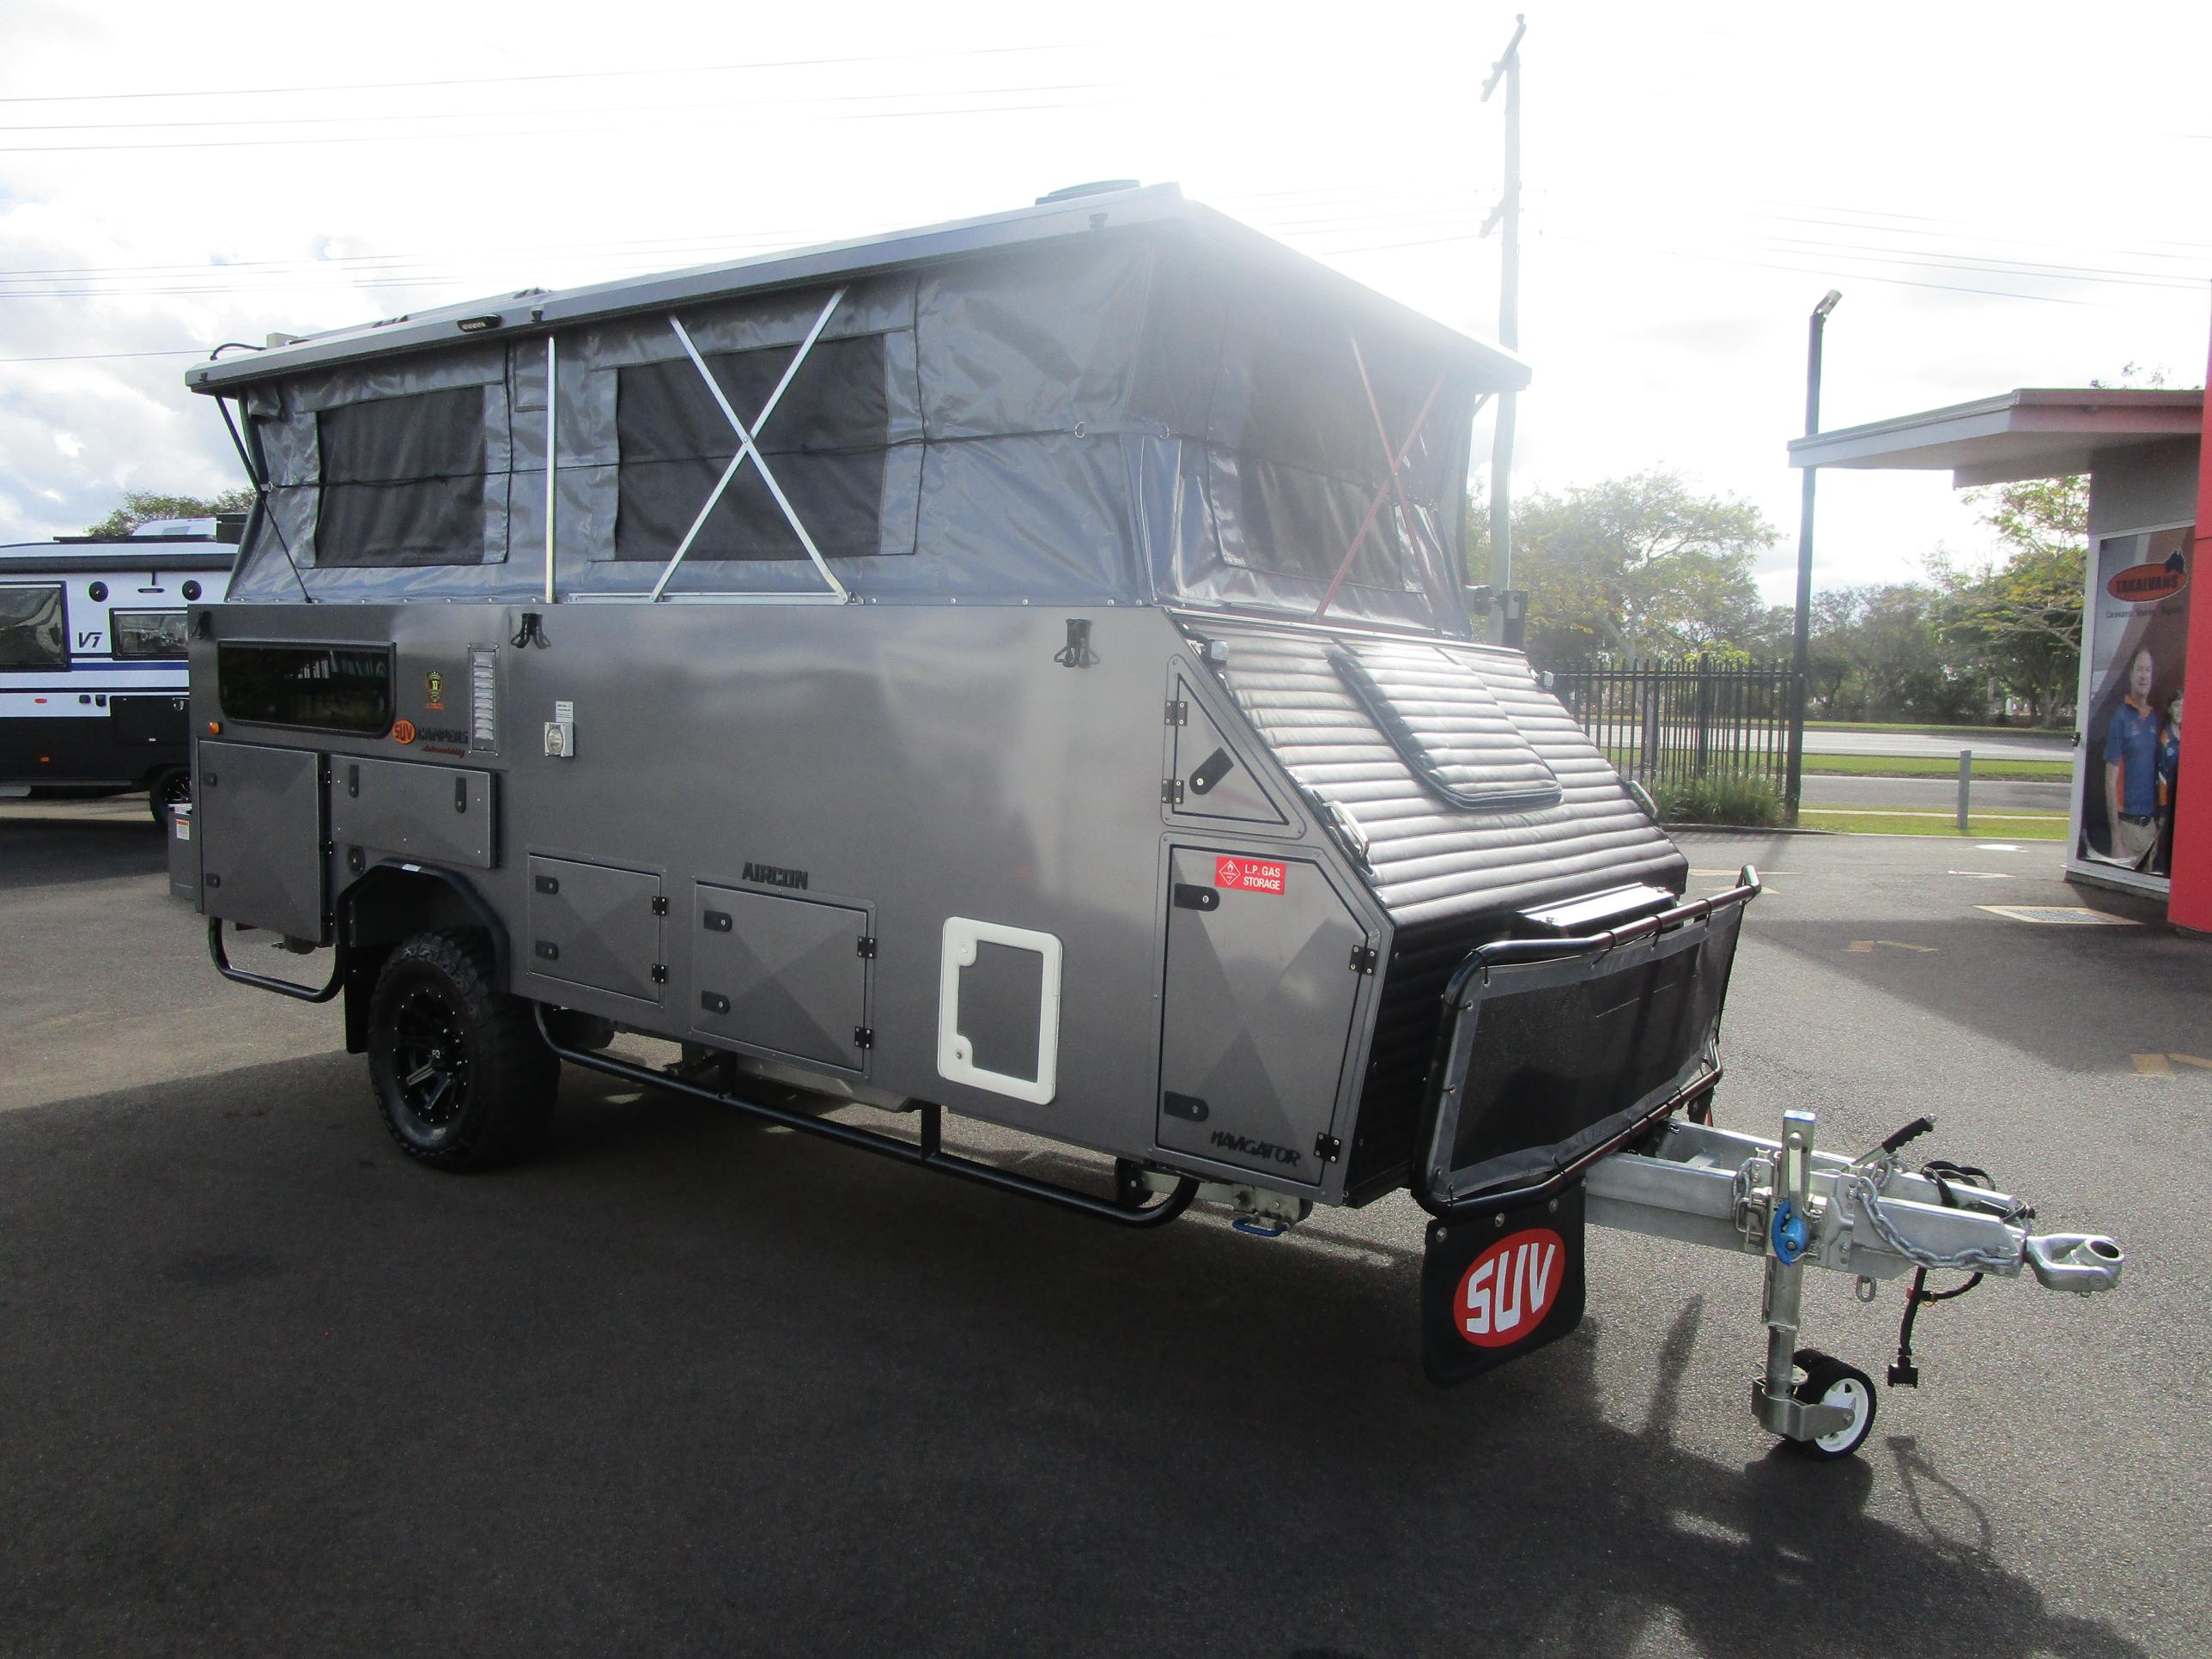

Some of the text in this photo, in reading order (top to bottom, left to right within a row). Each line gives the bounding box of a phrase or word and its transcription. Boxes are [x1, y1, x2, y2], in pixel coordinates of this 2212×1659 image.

[394, 723, 469, 744] SUV CAMPERS
[742, 862, 809, 890] AIRCON
[1261, 866, 1280, 878] GAS
[1243, 876, 1280, 890] STORAGE
[1467, 1243, 1556, 1334] SUV
